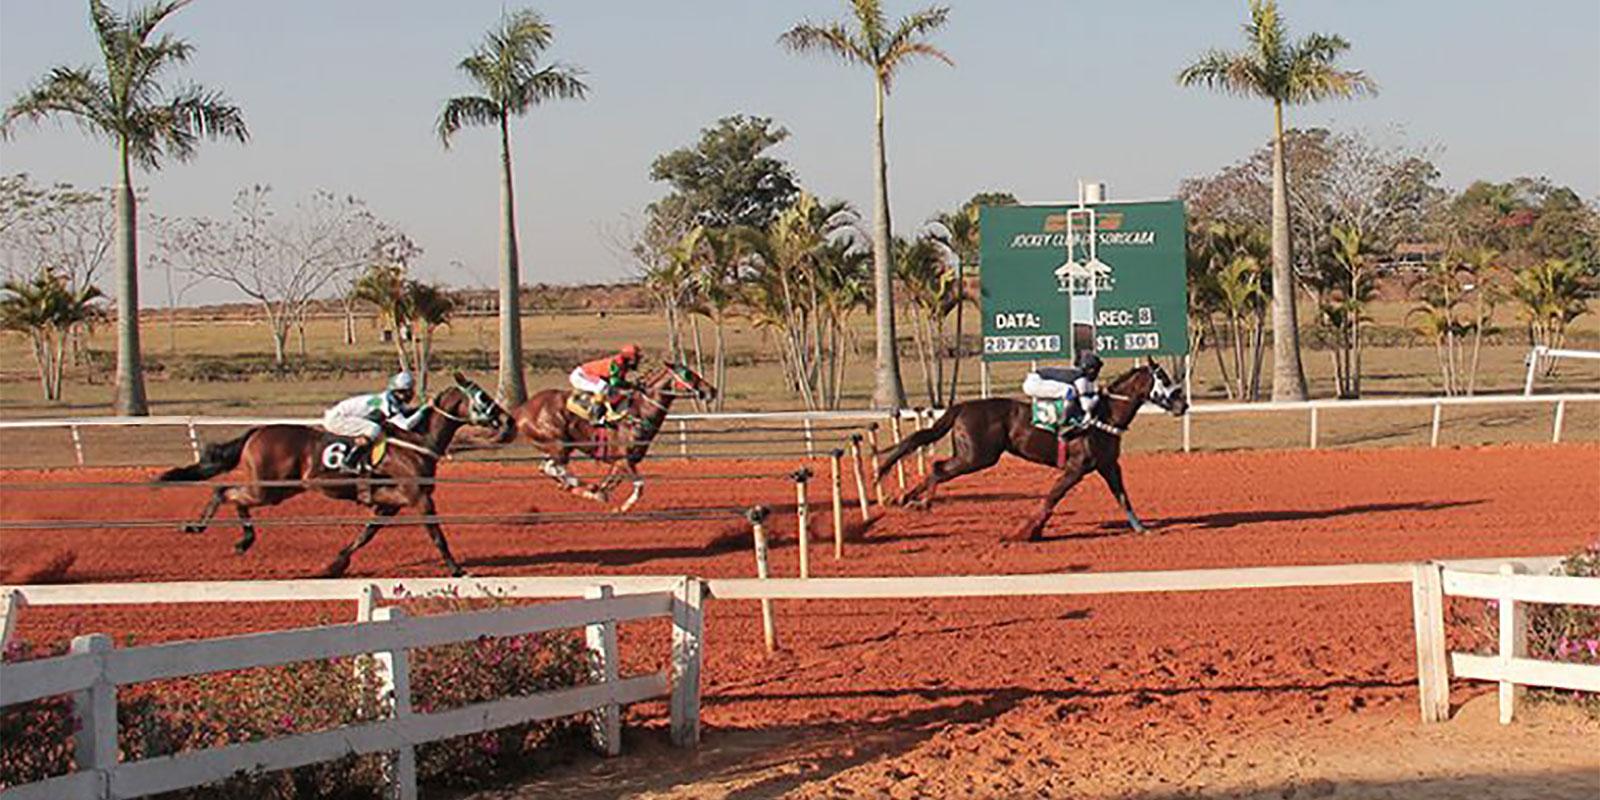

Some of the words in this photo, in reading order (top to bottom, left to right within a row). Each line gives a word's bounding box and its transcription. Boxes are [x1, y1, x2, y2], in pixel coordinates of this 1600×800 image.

[996, 313, 1040, 329] DATA:
[1096, 335, 1119, 351] ST:
[322, 442, 347, 470] 6
